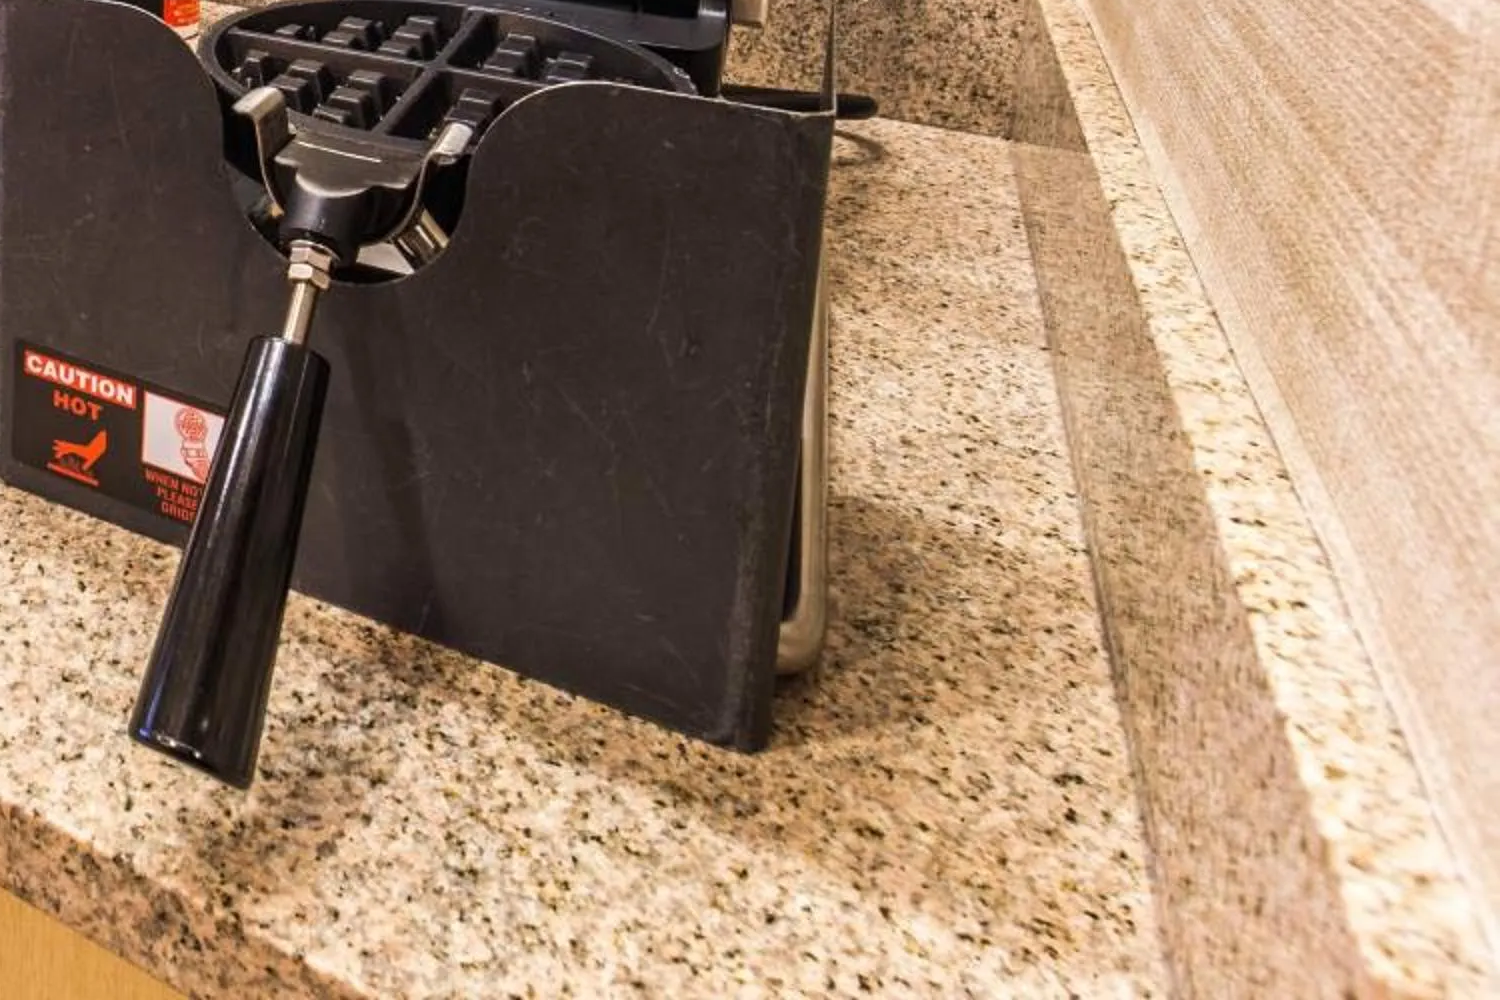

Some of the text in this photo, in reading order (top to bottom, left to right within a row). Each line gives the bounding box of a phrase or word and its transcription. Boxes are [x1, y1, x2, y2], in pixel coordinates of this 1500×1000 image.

[26, 354, 134, 405] CAUTION
[53, 390, 102, 420] HOT
[145, 467, 179, 489] WHEN
[157, 486, 197, 511] PLEASE
